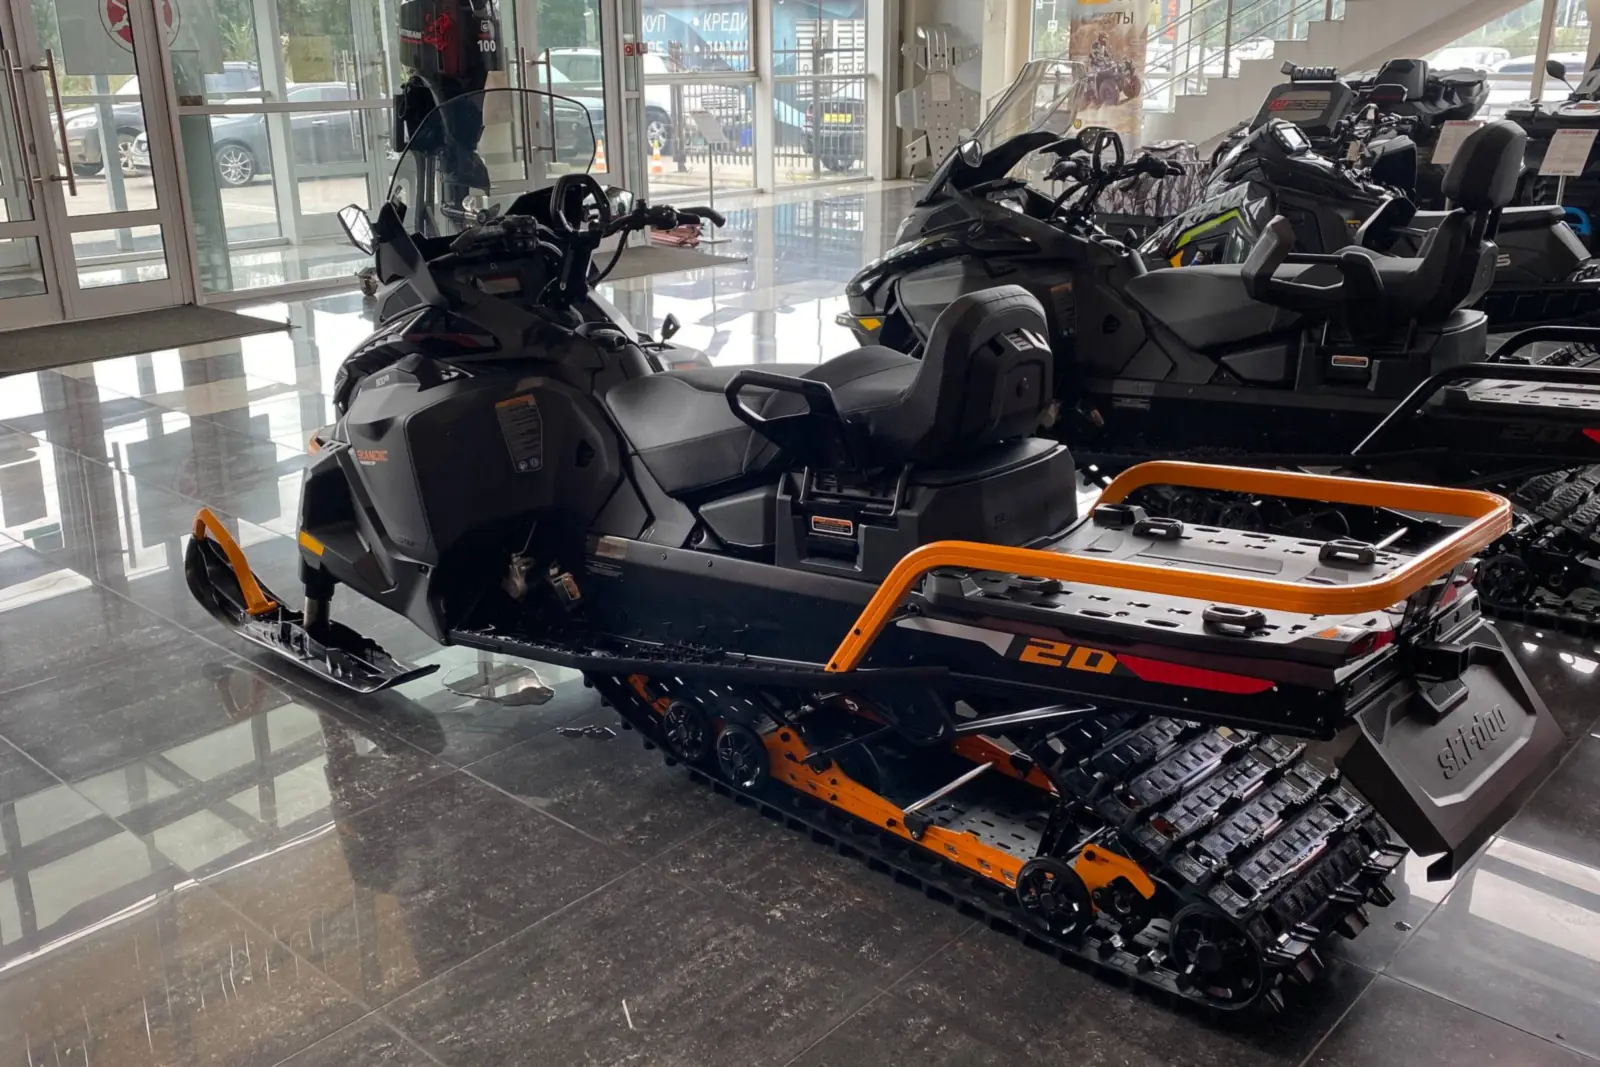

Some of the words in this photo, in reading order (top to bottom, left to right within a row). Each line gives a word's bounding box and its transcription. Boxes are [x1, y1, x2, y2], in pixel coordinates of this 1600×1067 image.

[477, 40, 496, 52] 100
[1019, 637, 1117, 674] 20
[1438, 703, 1508, 779] ski-doo
